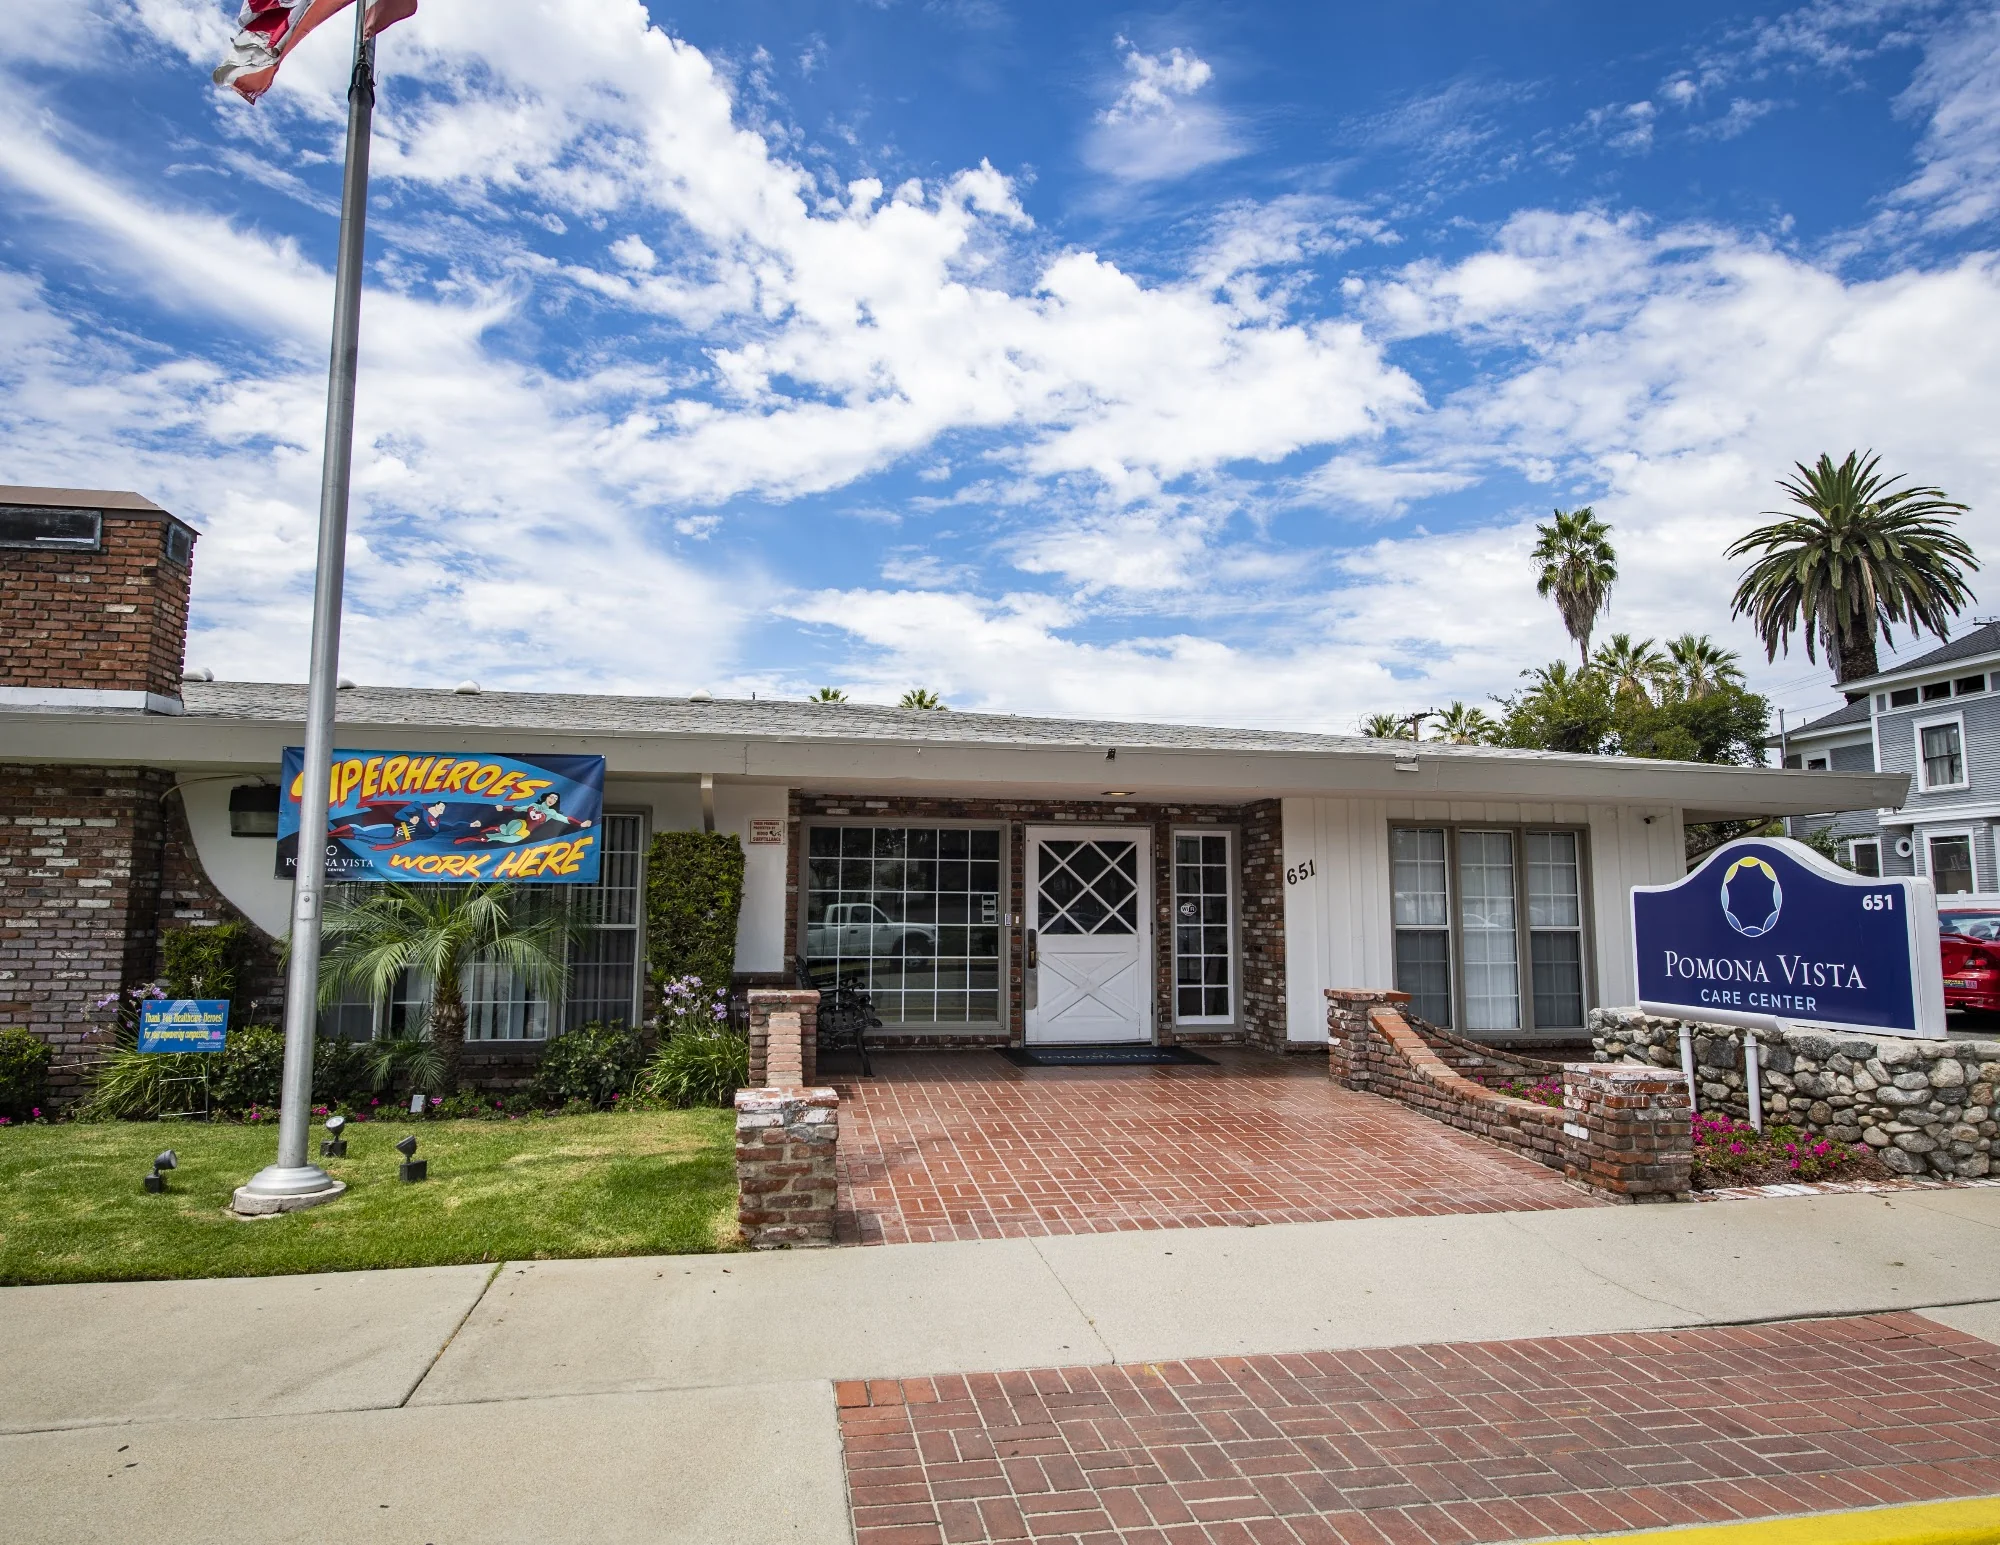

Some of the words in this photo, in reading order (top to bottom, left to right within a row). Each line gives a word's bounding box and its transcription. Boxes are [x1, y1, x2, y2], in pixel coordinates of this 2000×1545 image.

[341, 858, 374, 868] VISTA
[390, 854, 490, 877] WORK
[494, 836, 594, 878] HERE
[1287, 859, 1315, 885] 651
[1862, 895, 1893, 911] 651
[1664, 951, 1770, 983] POMONA
[1777, 954, 1867, 989] VISTA
[1701, 989, 1742, 1005] CARE
[1749, 993, 1817, 1012] CENTER
[145, 1013, 161, 1023] Thank
[173, 1012, 201, 1023] Healthcare
